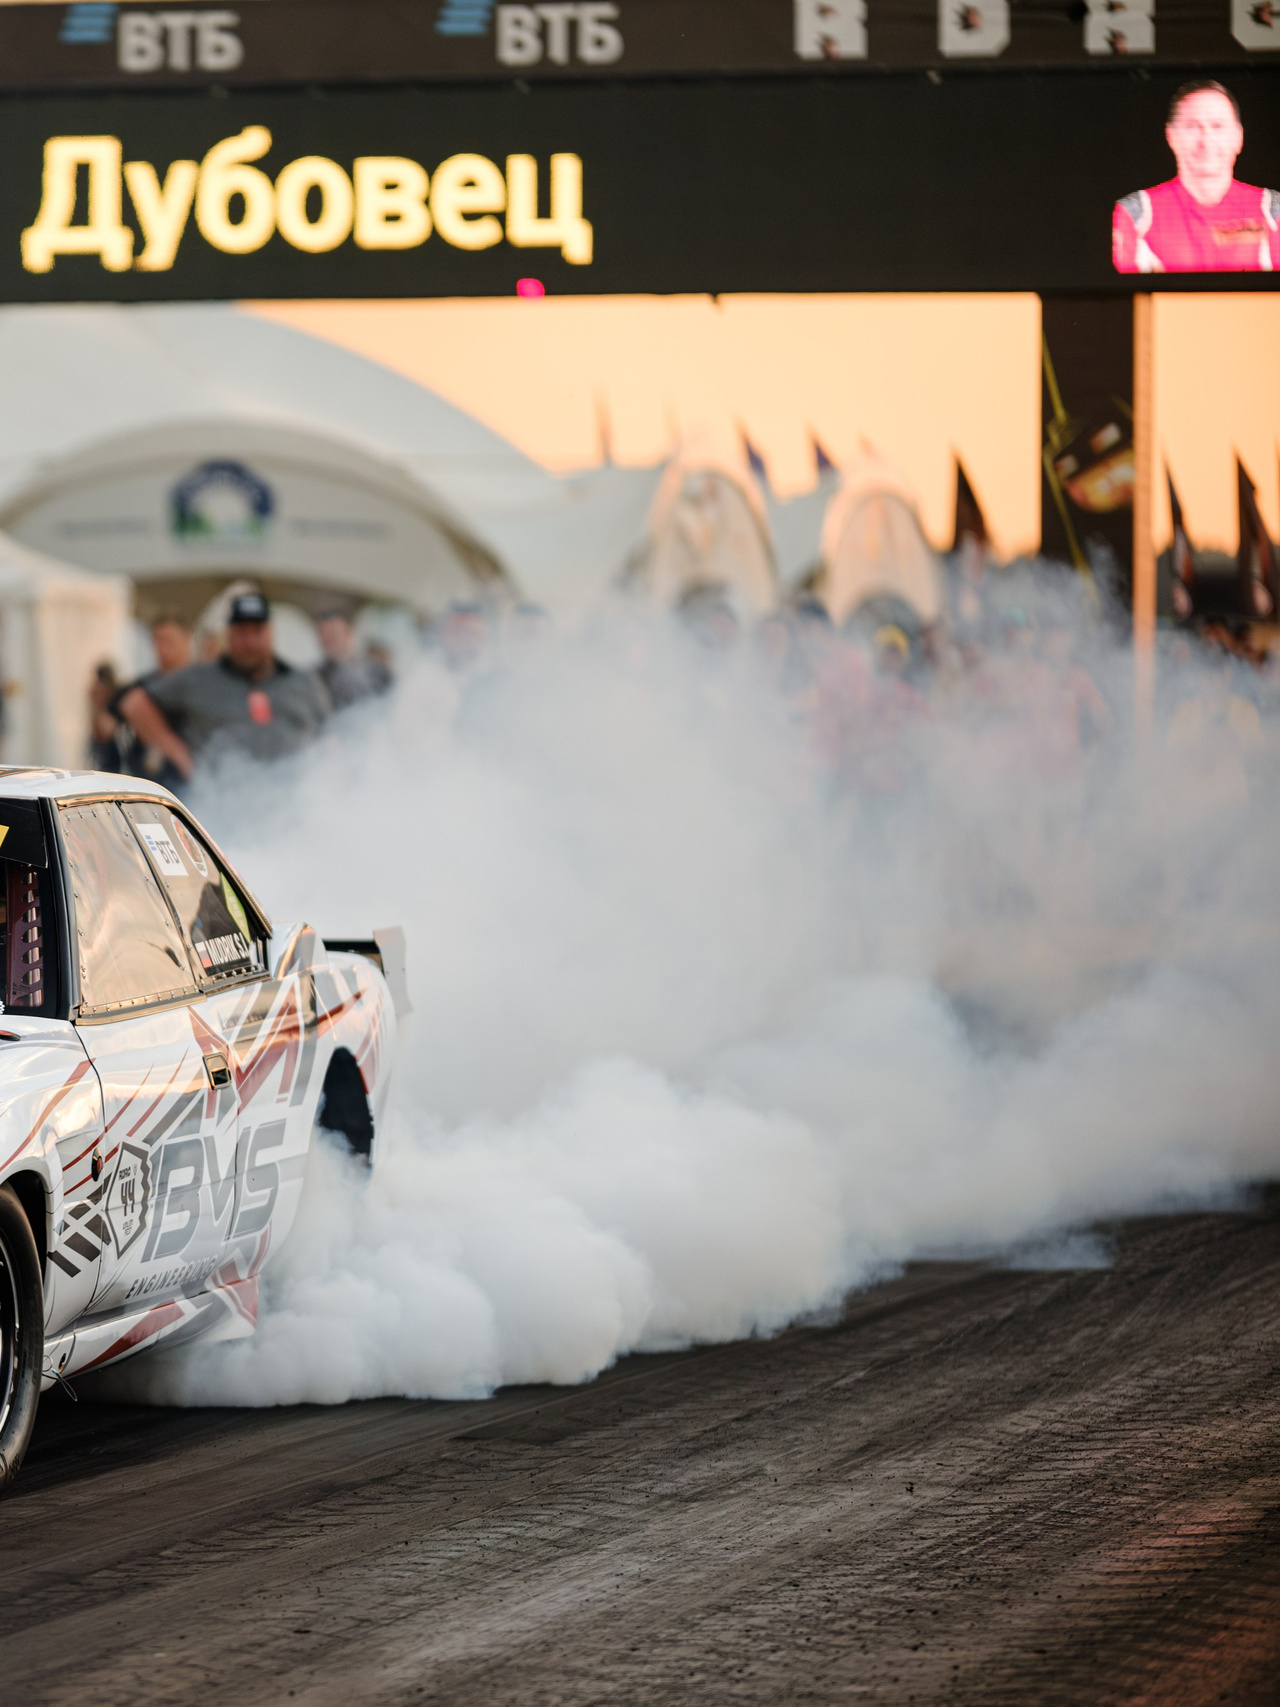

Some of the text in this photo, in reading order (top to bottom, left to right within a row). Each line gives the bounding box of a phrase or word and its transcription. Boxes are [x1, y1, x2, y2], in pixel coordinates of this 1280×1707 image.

[117, 10, 244, 72] ВТБ
[494, 3, 624, 66] ВТБ
[21, 125, 593, 273] Дубовец
[155, 840, 181, 864] ВТБ
[121, 1178, 136, 1217] 44
[140, 1118, 288, 1264] BMS
[125, 1255, 219, 1300] ENGINEERING
